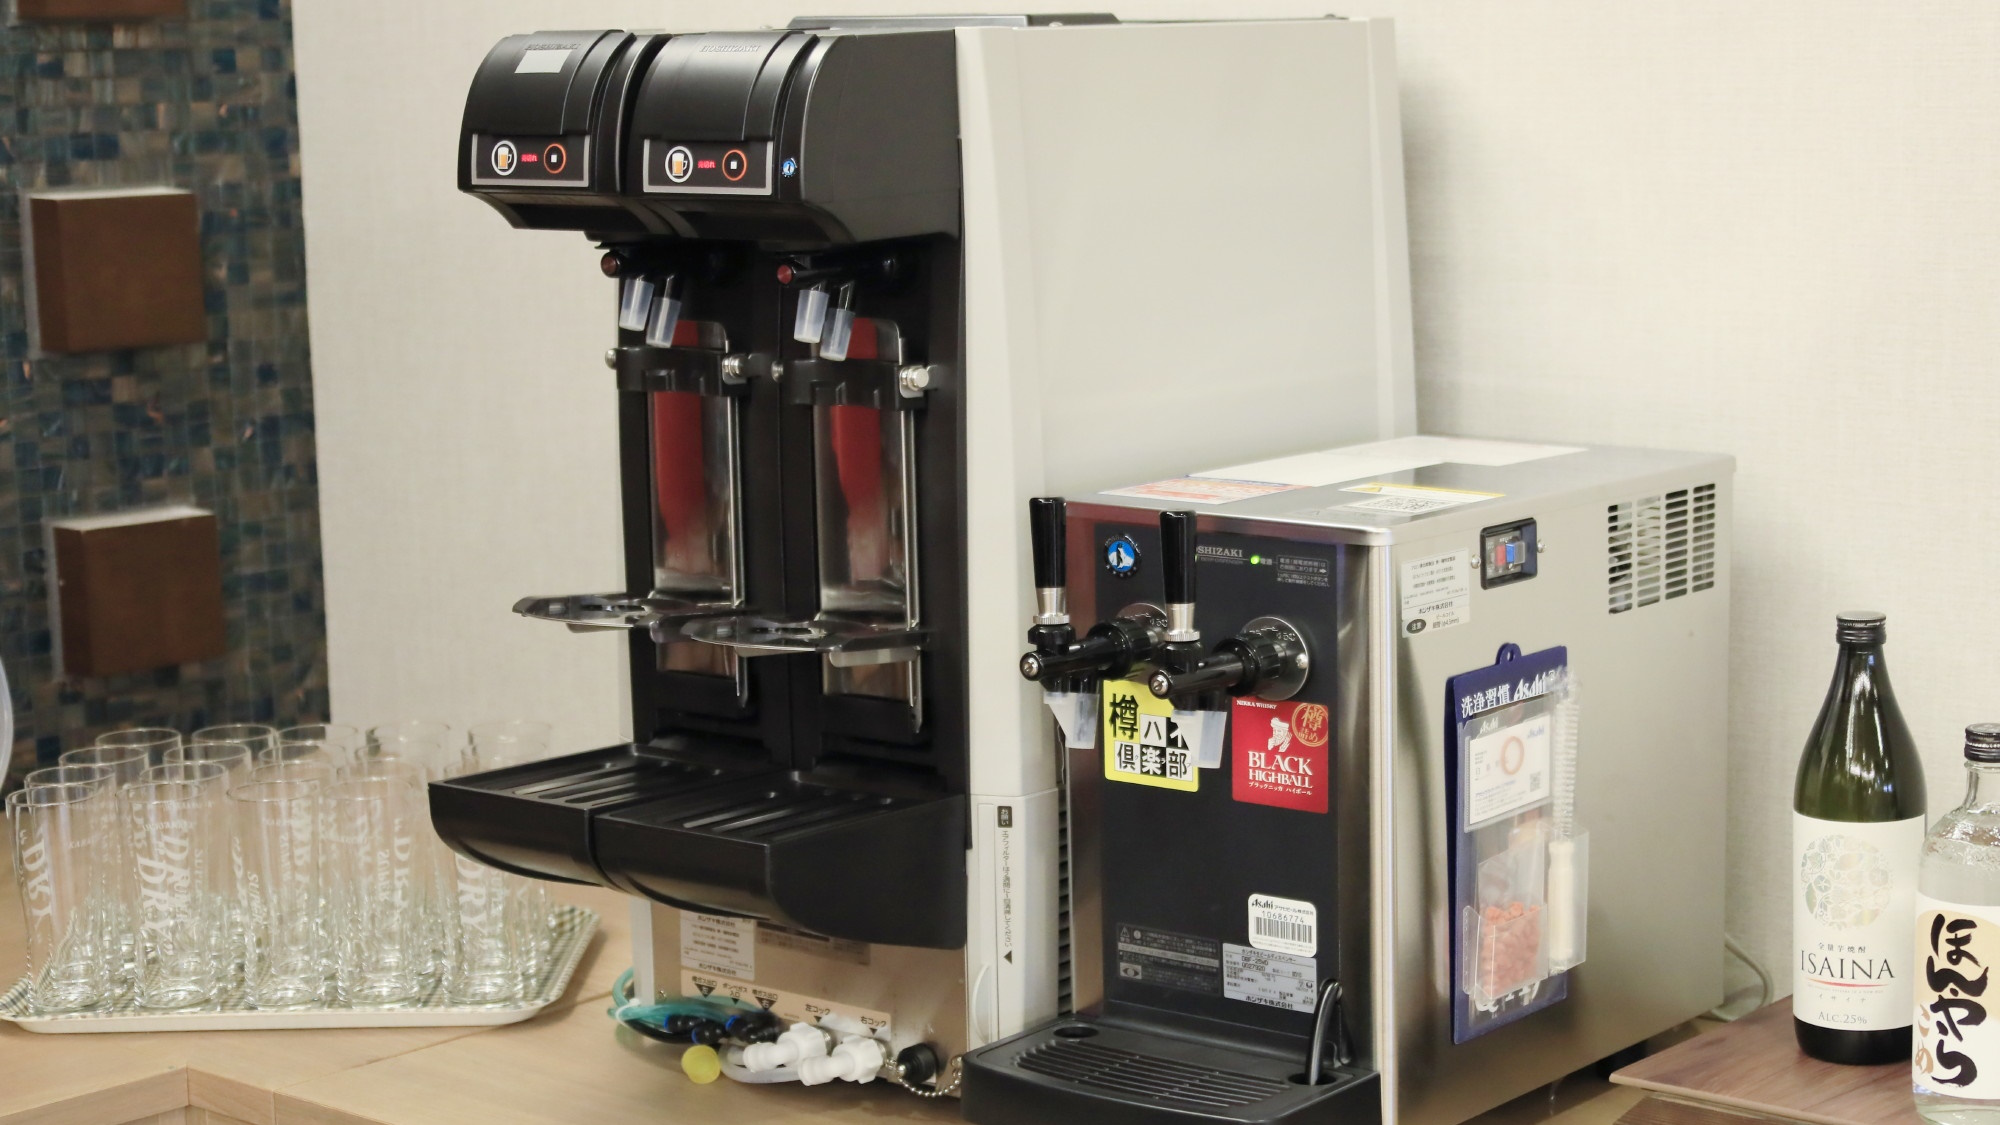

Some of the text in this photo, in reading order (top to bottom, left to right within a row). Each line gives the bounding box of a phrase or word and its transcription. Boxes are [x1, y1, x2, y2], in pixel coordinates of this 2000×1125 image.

[1196, 546, 1243, 557] SHIZAKI
[1461, 683, 1510, 719] 洗浄習慣
[1117, 743, 1188, 778] 倶楽部
[1248, 751, 1313, 776] BLACK
[1249, 769, 1313, 789] HIGHBALL
[1248, 781, 1313, 796] ブラックニッカ ハイボール
[1251, 898, 1274, 910] Asahi
[1262, 910, 1305, 924] 10686774
[1818, 942, 1866, 954] 全量芋焼酎
[1801, 950, 1896, 980] ISAINA
[805, 1003, 831, 1016] 左コック
[860, 1015, 888, 1027] 右コック
[1818, 1011, 1867, 1025] ALC.25%
